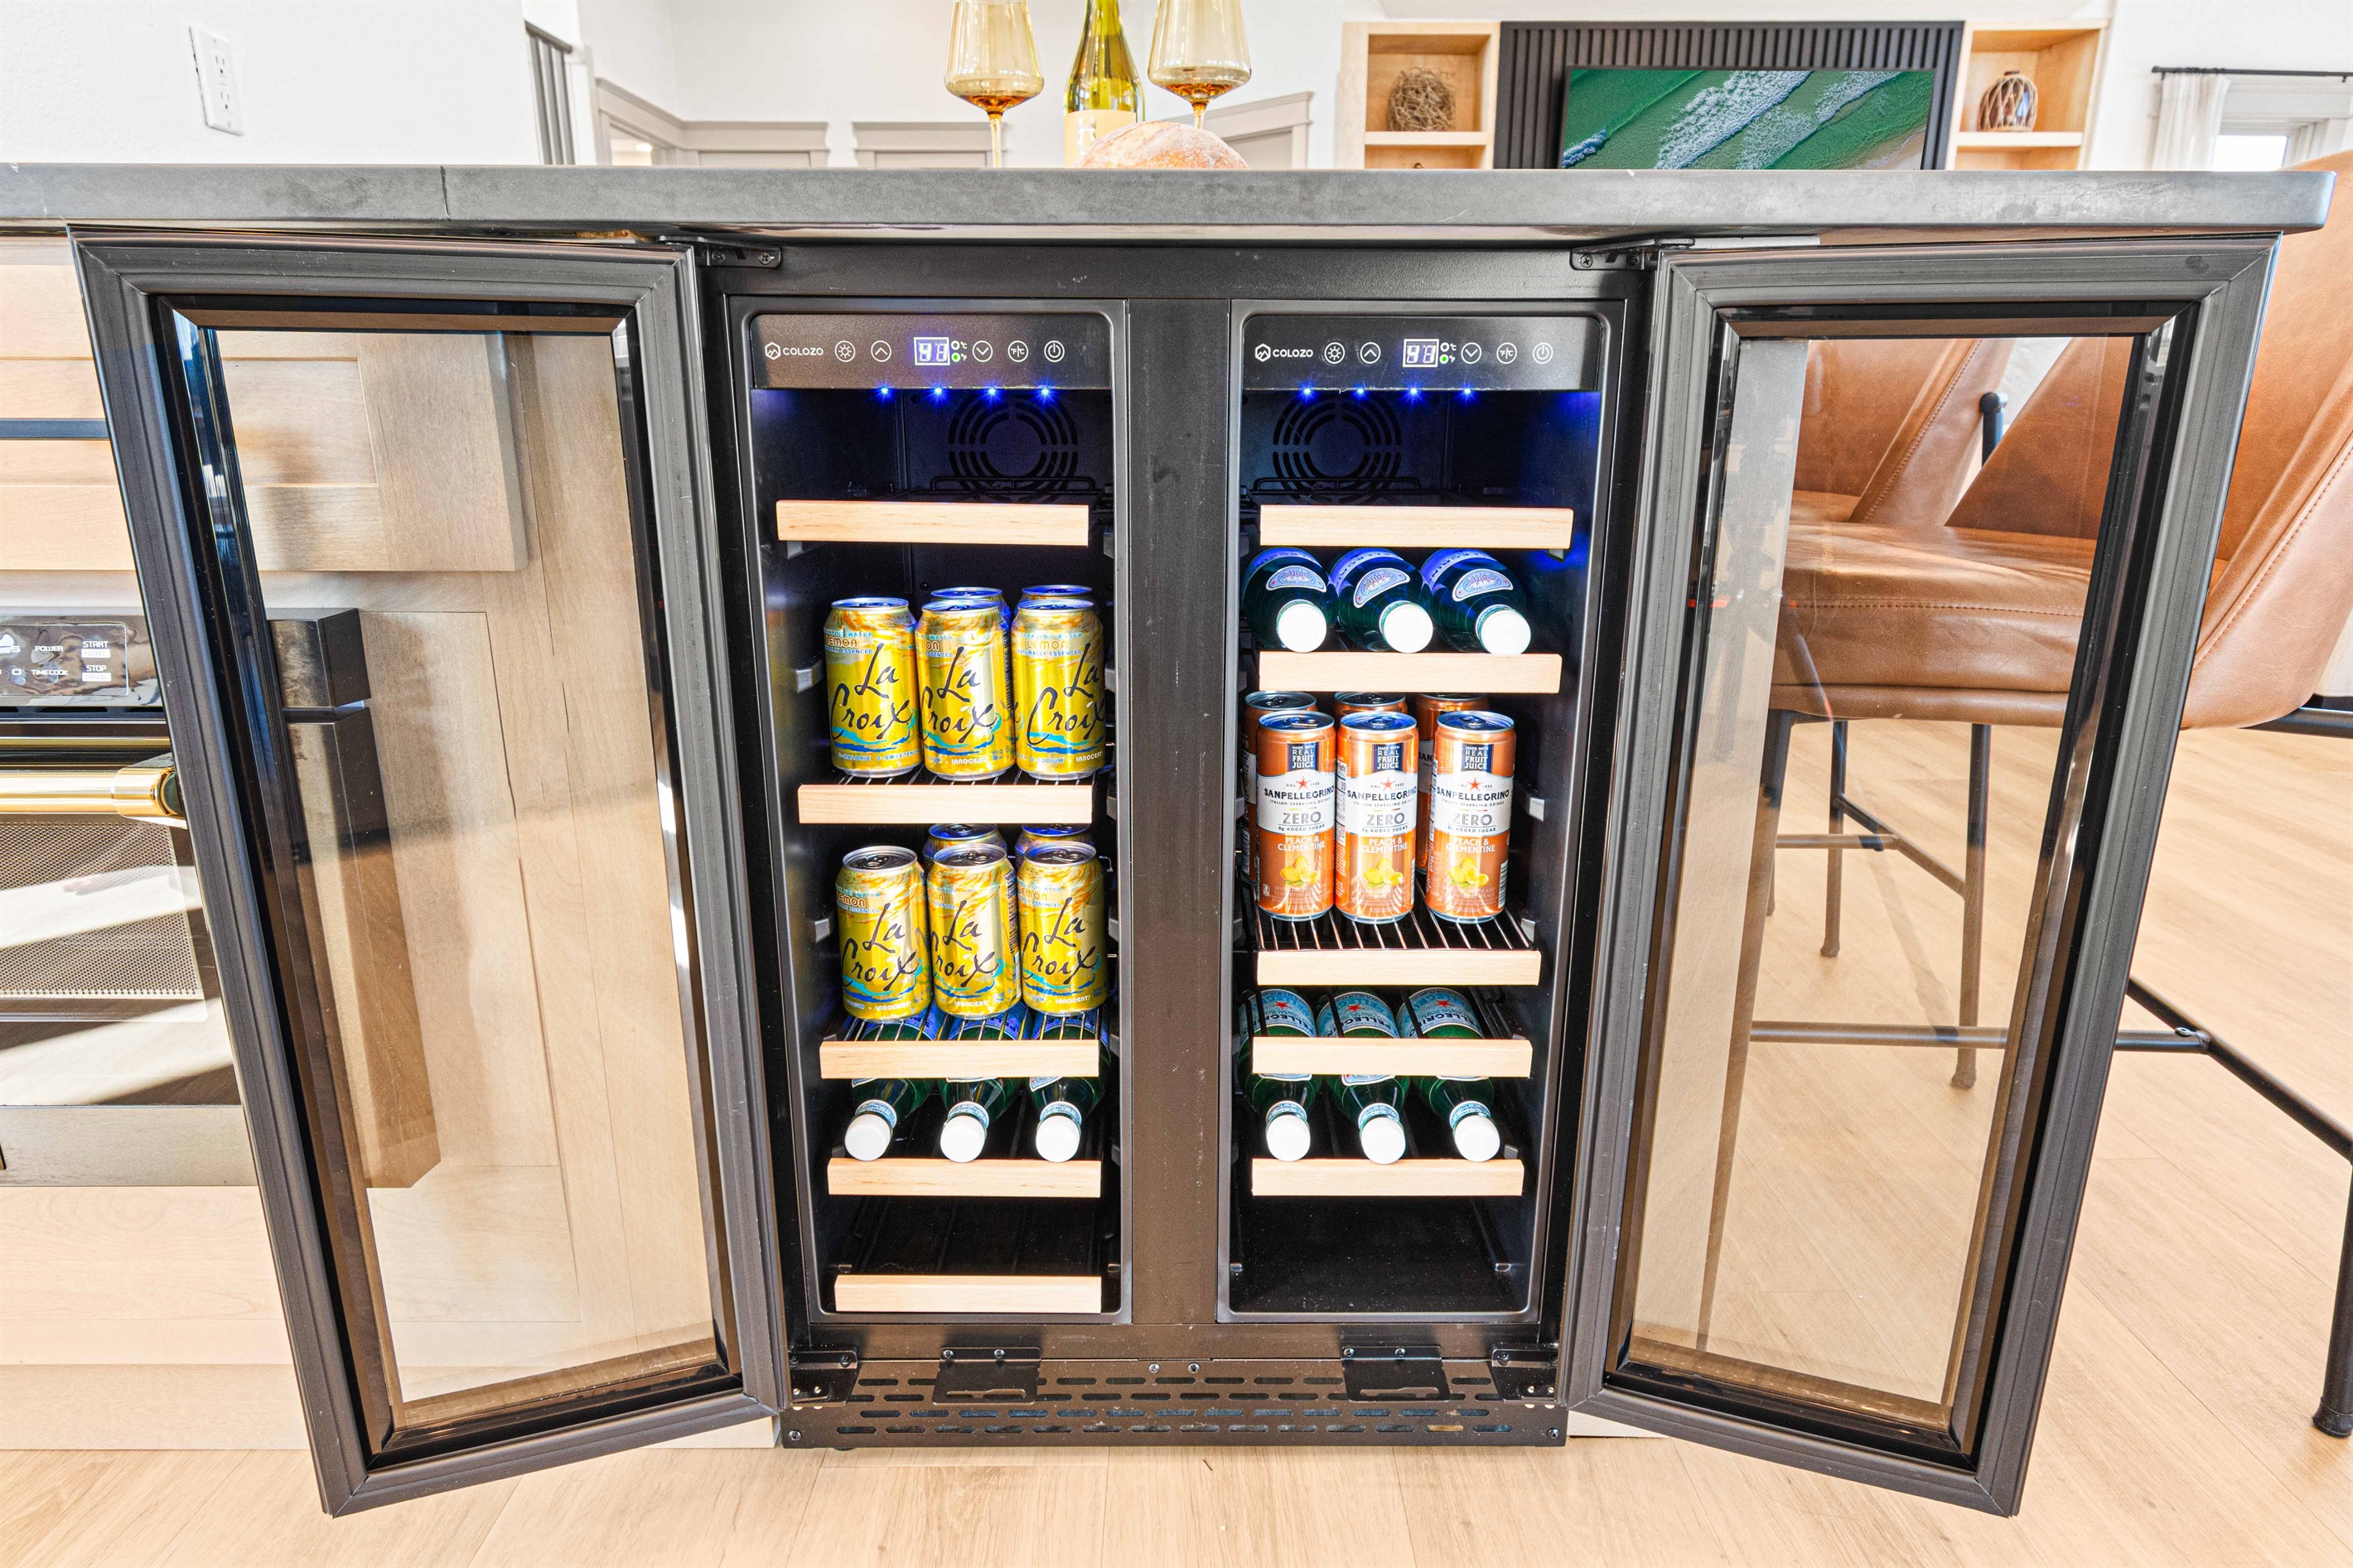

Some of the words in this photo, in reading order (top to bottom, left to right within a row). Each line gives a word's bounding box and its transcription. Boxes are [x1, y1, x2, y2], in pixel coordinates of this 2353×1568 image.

[782, 347, 824, 356] COLOZO
[1273, 349, 1313, 358] COLOZO
[1026, 639, 1067, 650] LEMON
[854, 643, 899, 698] La
[937, 646, 981, 702] La
[1063, 643, 1100, 698] La
[831, 683, 913, 740] Croix
[1027, 687, 1105, 745] Croix
[1264, 784, 1335, 800] SANPELLEGRINO
[1347, 786, 1417, 801] SANPELLEGRINO
[1437, 789, 1510, 801] SANPELLEGRINO
[1283, 811, 1321, 825] ZERO
[1366, 812, 1405, 826] ZERO
[1452, 812, 1493, 826] ZERO
[1278, 840, 1326, 852] CLEMENTINE
[1285, 836, 1312, 845] PEACH
[1361, 842, 1408, 853] CLEMENTINE
[1369, 837, 1396, 846] PEACH
[1455, 837, 1482, 846] PEACH
[862, 902, 906, 953] La
[943, 900, 983, 951] La
[1044, 897, 1085, 948] La
[842, 938, 920, 991] Croix
[1022, 932, 1099, 985] Croix
